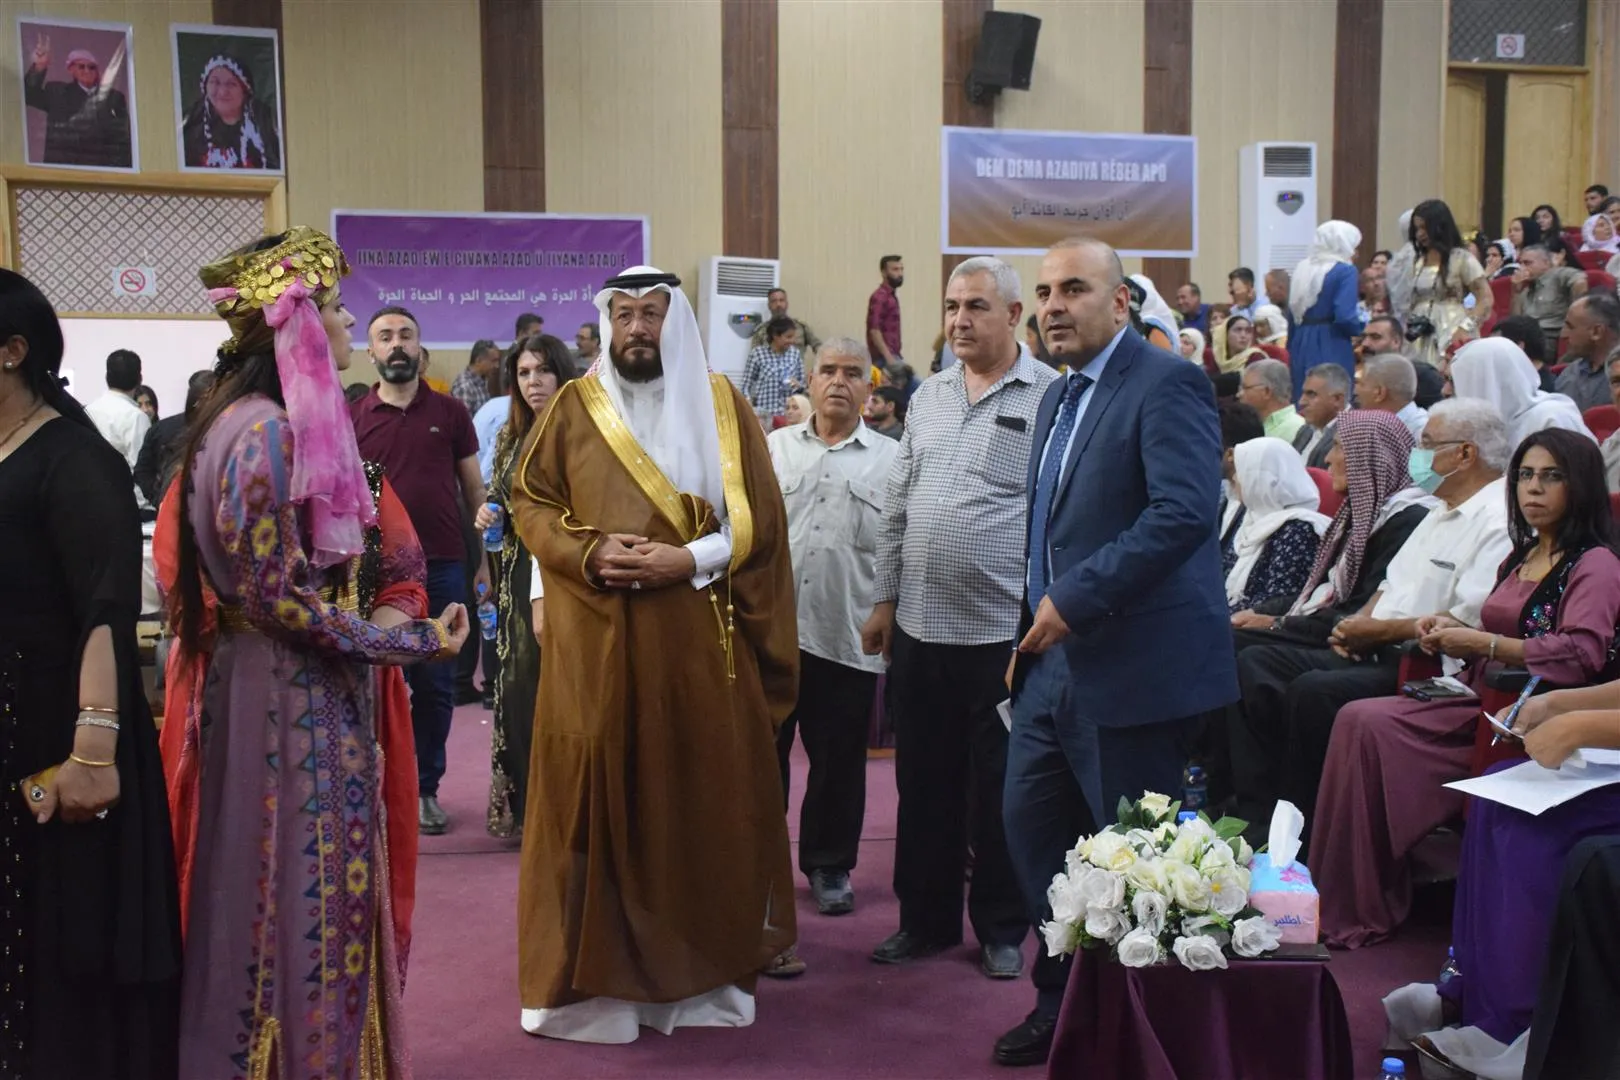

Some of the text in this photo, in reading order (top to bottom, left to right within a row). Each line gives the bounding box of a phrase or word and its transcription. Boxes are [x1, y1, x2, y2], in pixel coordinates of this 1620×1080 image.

[976, 156, 1004, 178] DEM
[1007, 158, 1044, 179] DEMA
[1045, 159, 1098, 181] AZADIYA
[1142, 162, 1167, 183] APO
[388, 250, 418, 267] AZAD
[502, 251, 531, 267] AZAD
[378, 287, 405, 304] الحرة
[410, 287, 442, 301] الحياة
[448, 292, 455, 304] و
[460, 288, 479, 305] الحر
[484, 288, 525, 305] المجتمع
[530, 291, 547, 308] هي
[552, 287, 577, 305] الحرة
